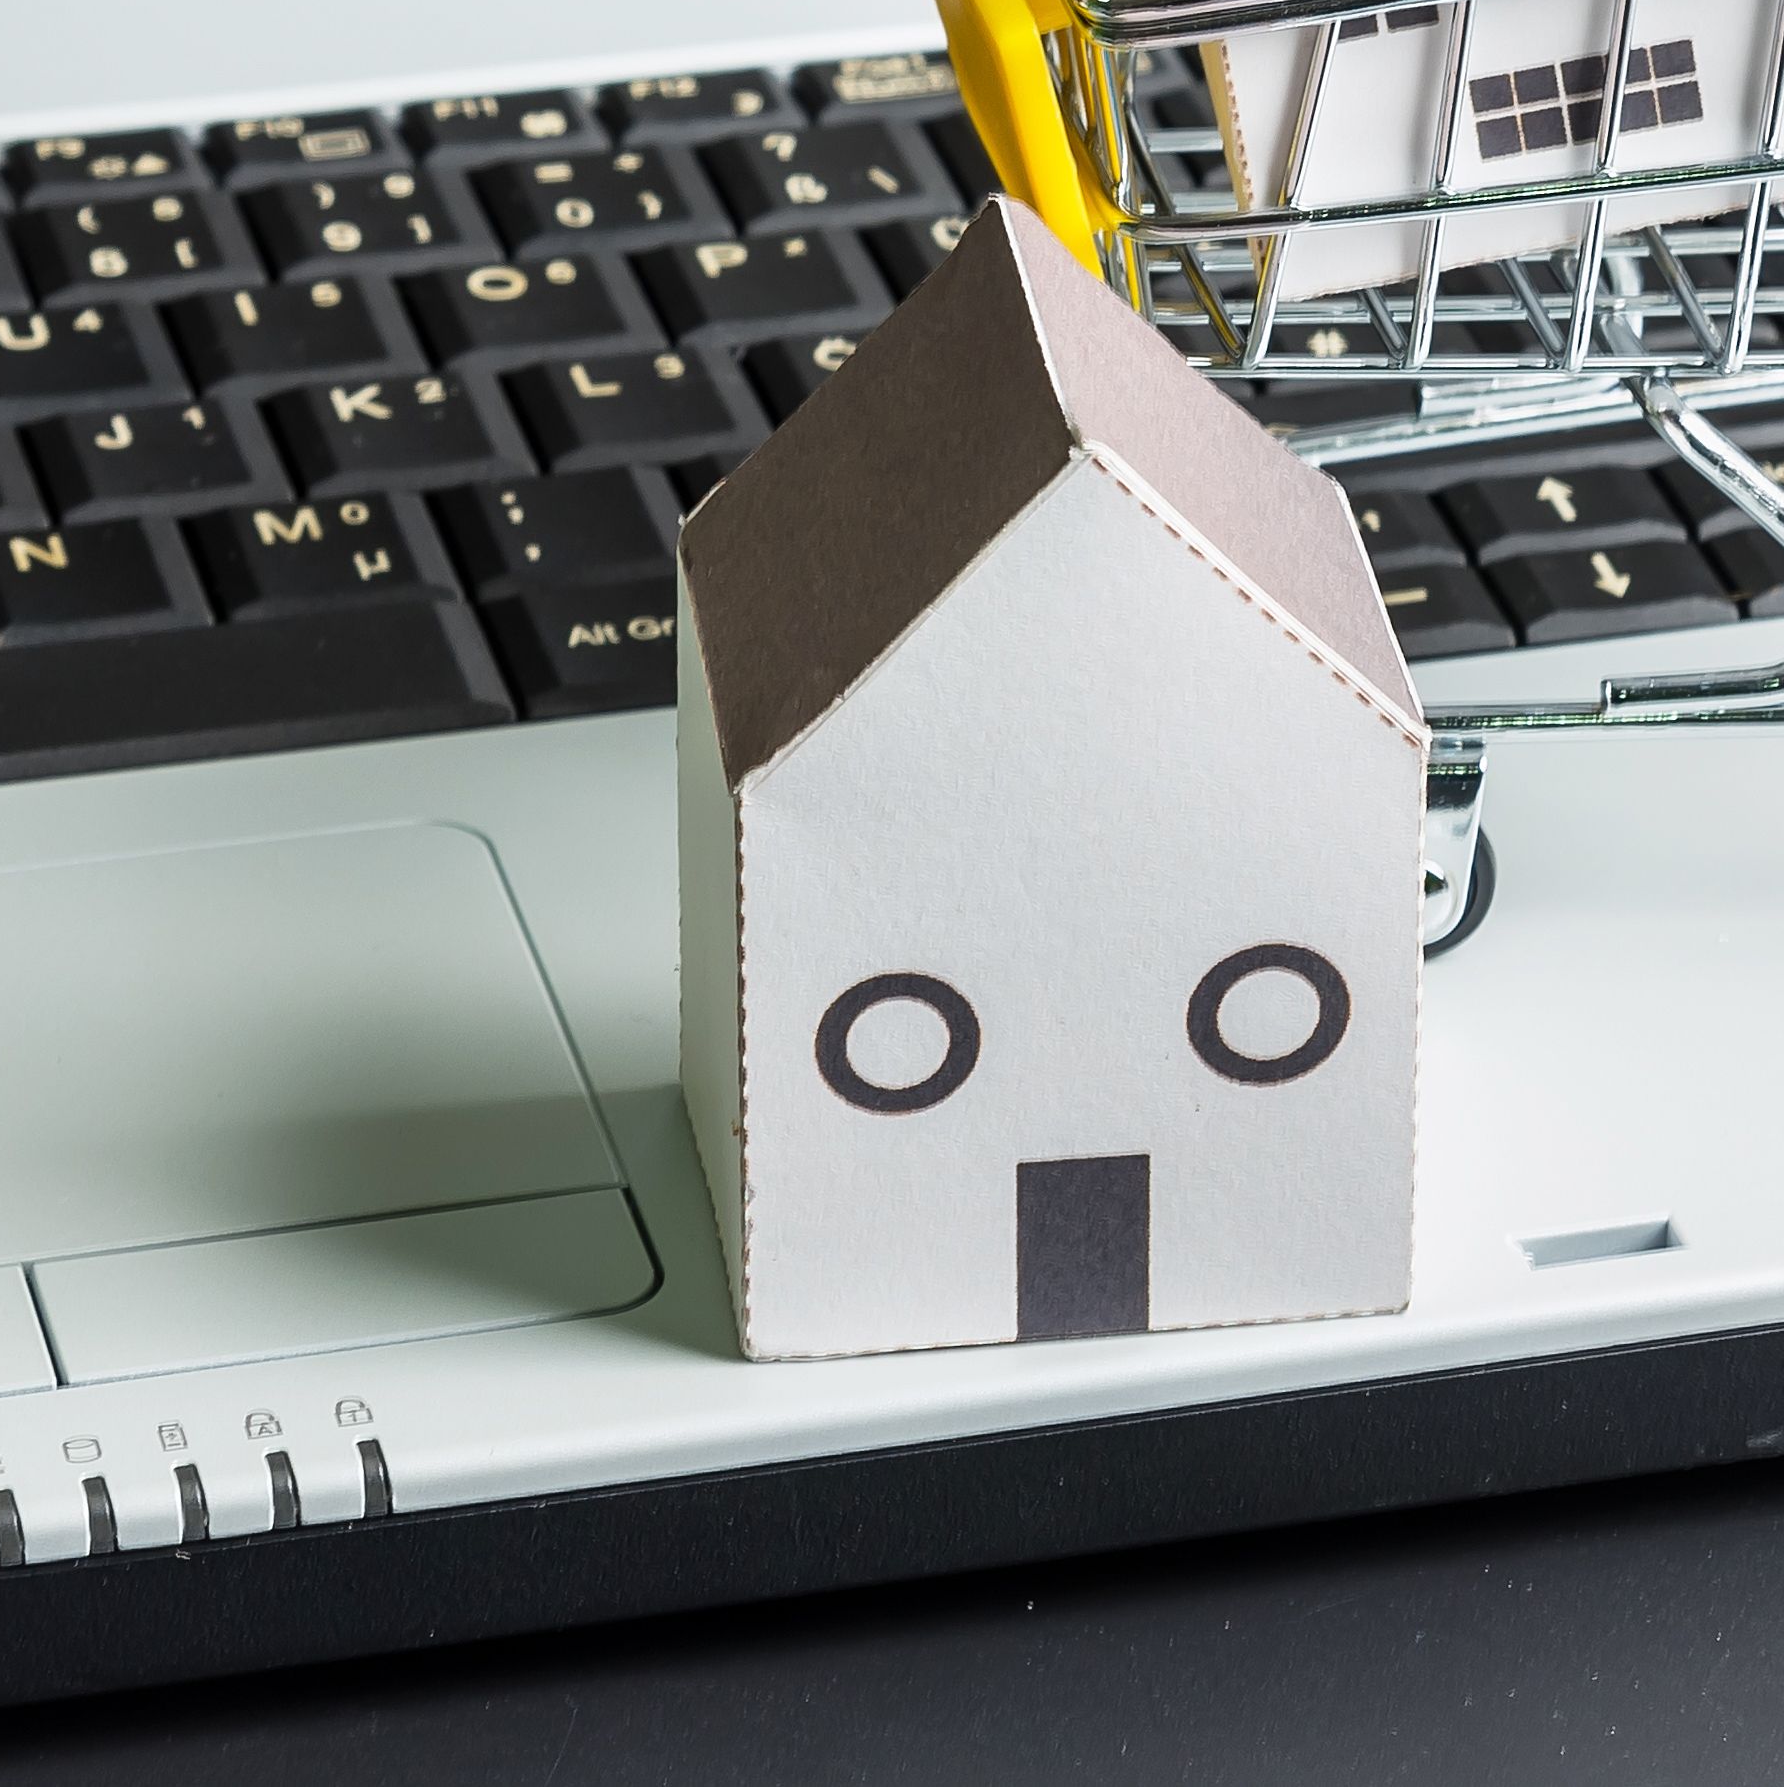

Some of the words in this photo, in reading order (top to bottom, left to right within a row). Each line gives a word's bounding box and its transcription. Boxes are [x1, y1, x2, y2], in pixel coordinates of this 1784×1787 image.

[695, 244, 748, 279] P
[466, 266, 529, 301] O
[569, 364, 620, 398] L
[330, 384, 392, 422] K
[95, 414, 133, 450] J
[253, 507, 322, 545] M
[9, 535, 68, 572] N
[568, 624, 619, 647] Alt
